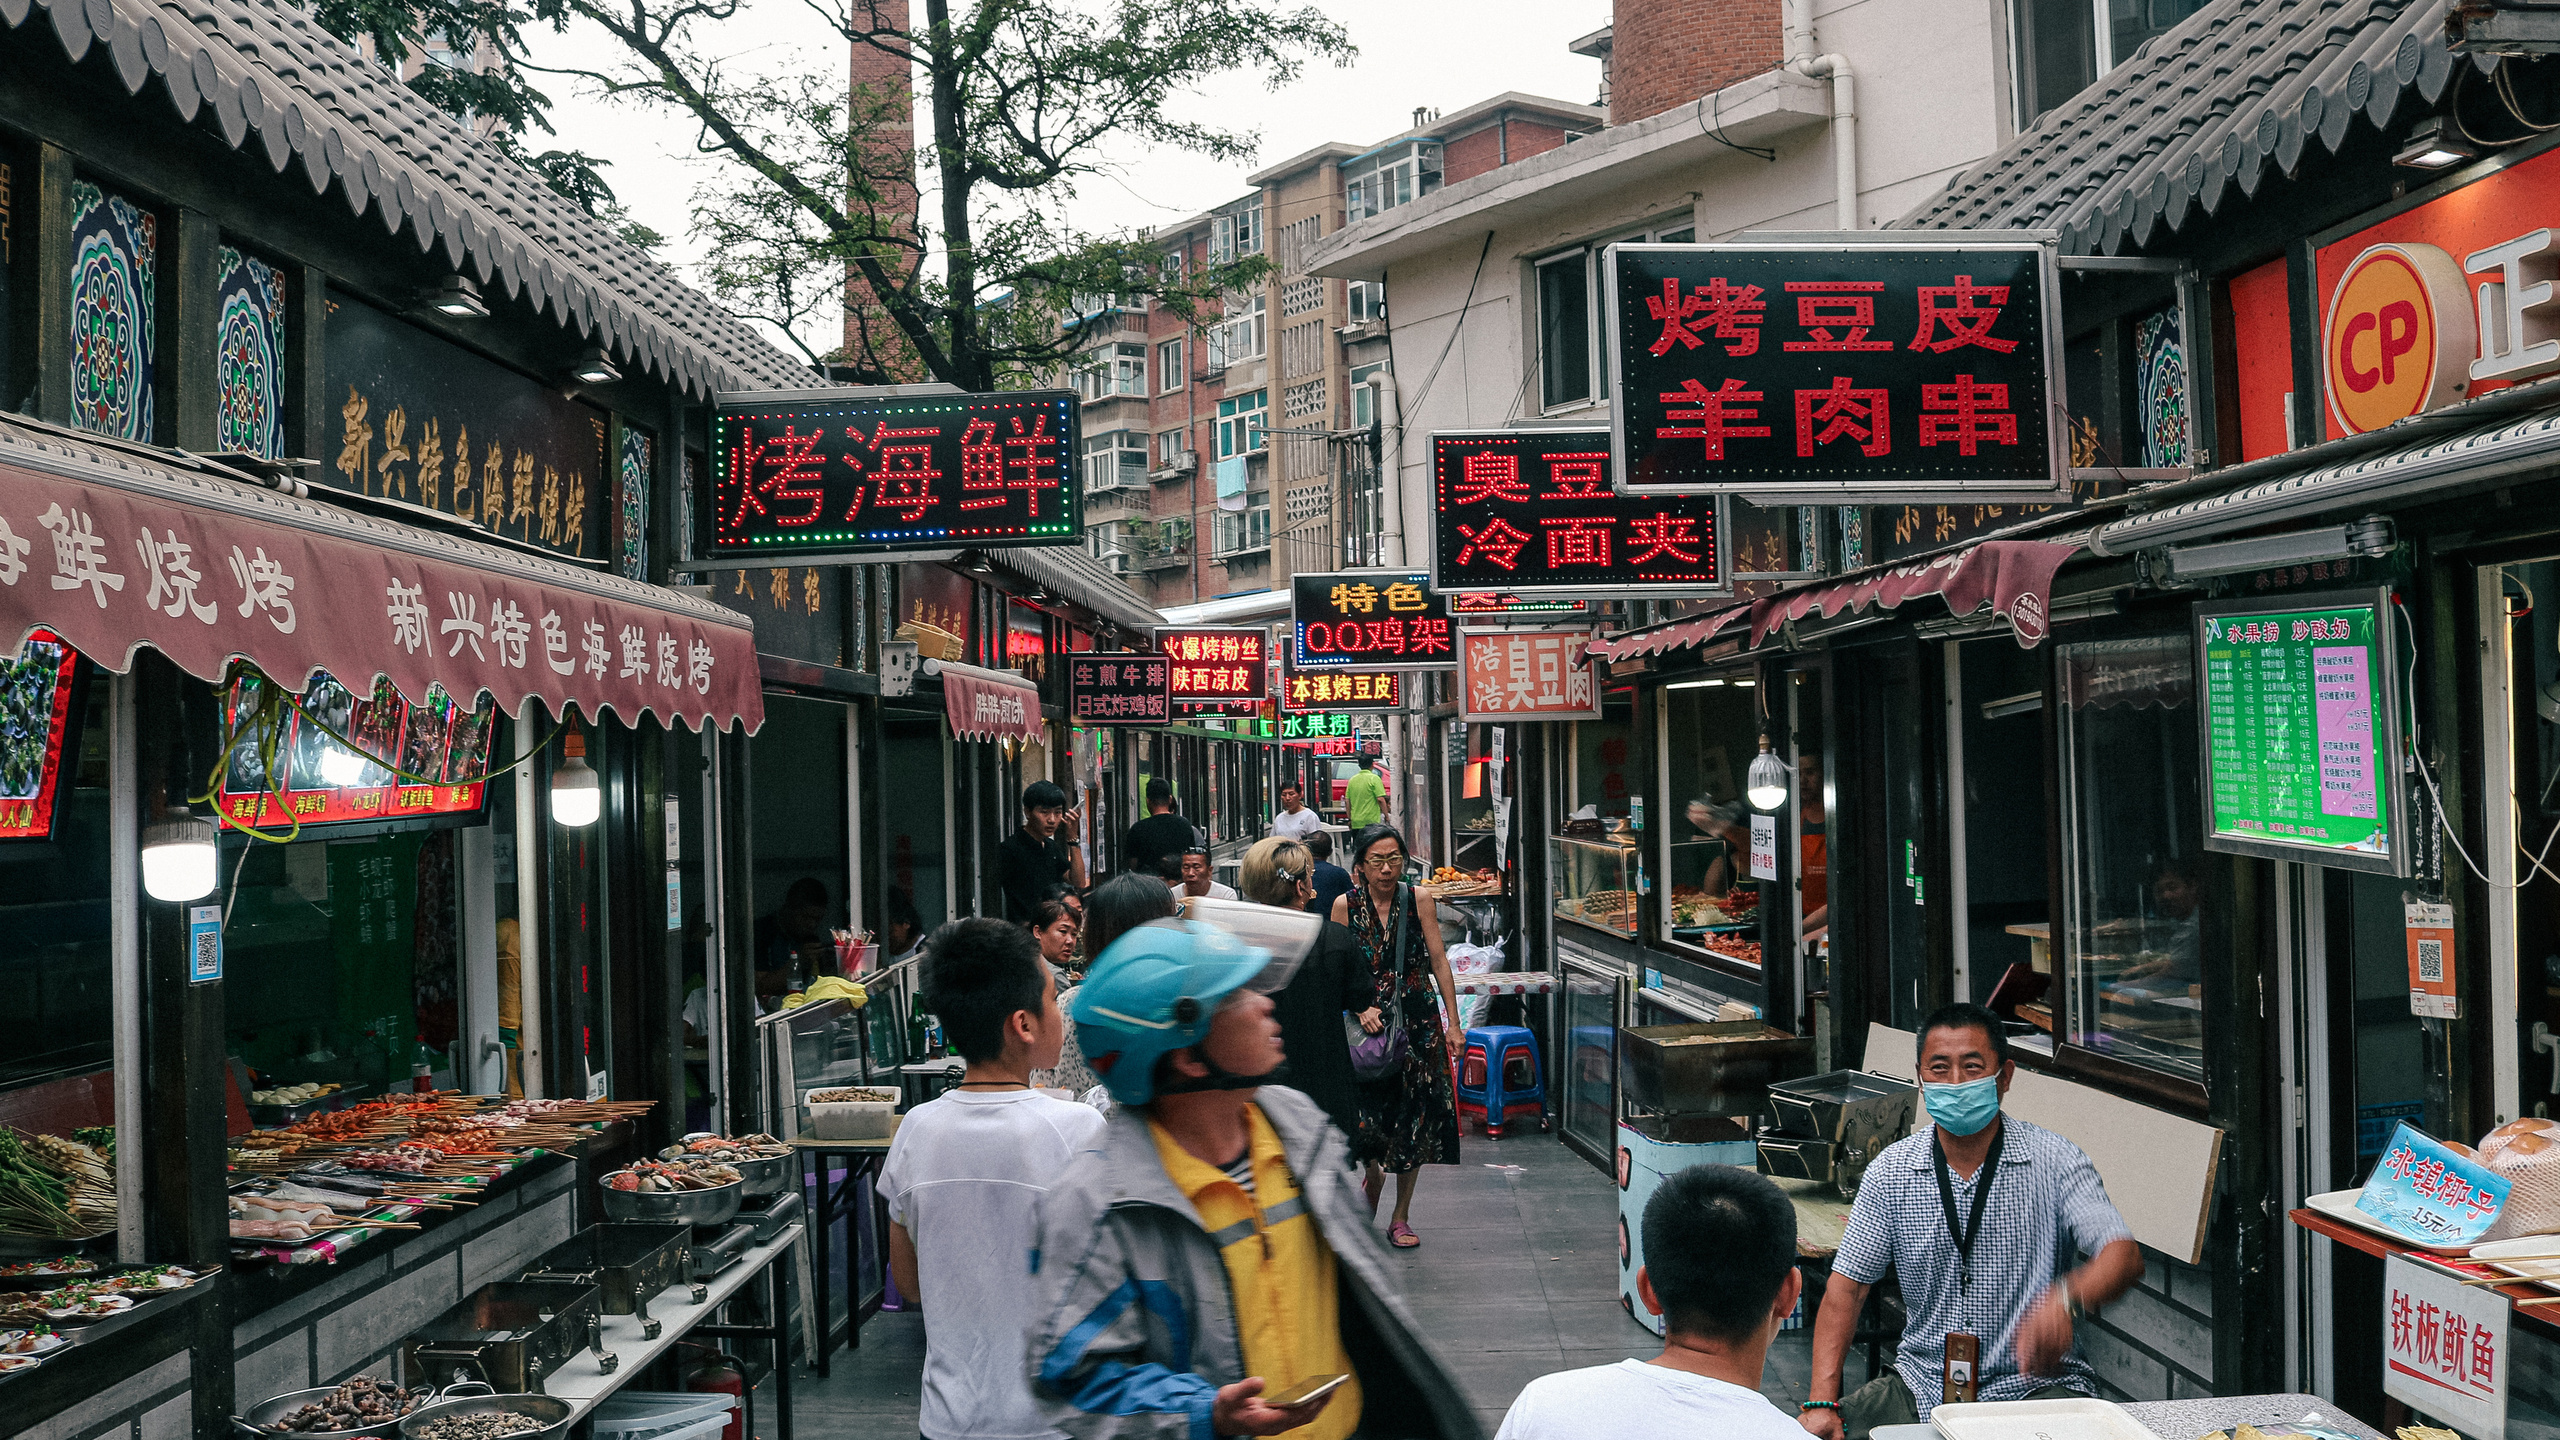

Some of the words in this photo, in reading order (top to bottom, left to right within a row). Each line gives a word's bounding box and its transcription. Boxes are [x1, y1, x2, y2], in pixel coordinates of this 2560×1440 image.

[1646, 275, 2019, 357] 烤豆皮
[2340, 300, 2418, 393] CP
[1657, 374, 2019, 461] 羊肉串
[730, 413, 1060, 528] 烤海鲜
[1454, 450, 1614, 504] 臭豆
[1455, 511, 1702, 571] 冷面夹
[1331, 582, 1428, 613] 特色
[386, 578, 715, 695] 新兴特色海鲜烧烤
[1164, 635, 1260, 662] 火爆烤粉丝
[1305, 616, 1450, 655] QQ鸡架
[2227, 622, 2280, 644] 水果捞
[2291, 618, 2350, 640] 炒酸奶
[1075, 664, 1165, 687] 生煎牛排
[1172, 666, 1250, 692] 陕西凉皮
[1292, 672, 1393, 702] 本溪烤豆皮
[1507, 633, 1591, 711] 臭豆腐
[974, 692, 1025, 725] 胖胖煎饼
[1077, 693, 1165, 717] 日式炸鸡饭
[1282, 713, 1350, 738] 水果捞
[0, 804, 33, 829] 人仙
[2385, 1146, 2498, 1221] 冰镇椰子
[2411, 1205, 2465, 1240] 15元/个
[2388, 1288, 2497, 1396] 铁板鱿鱼
